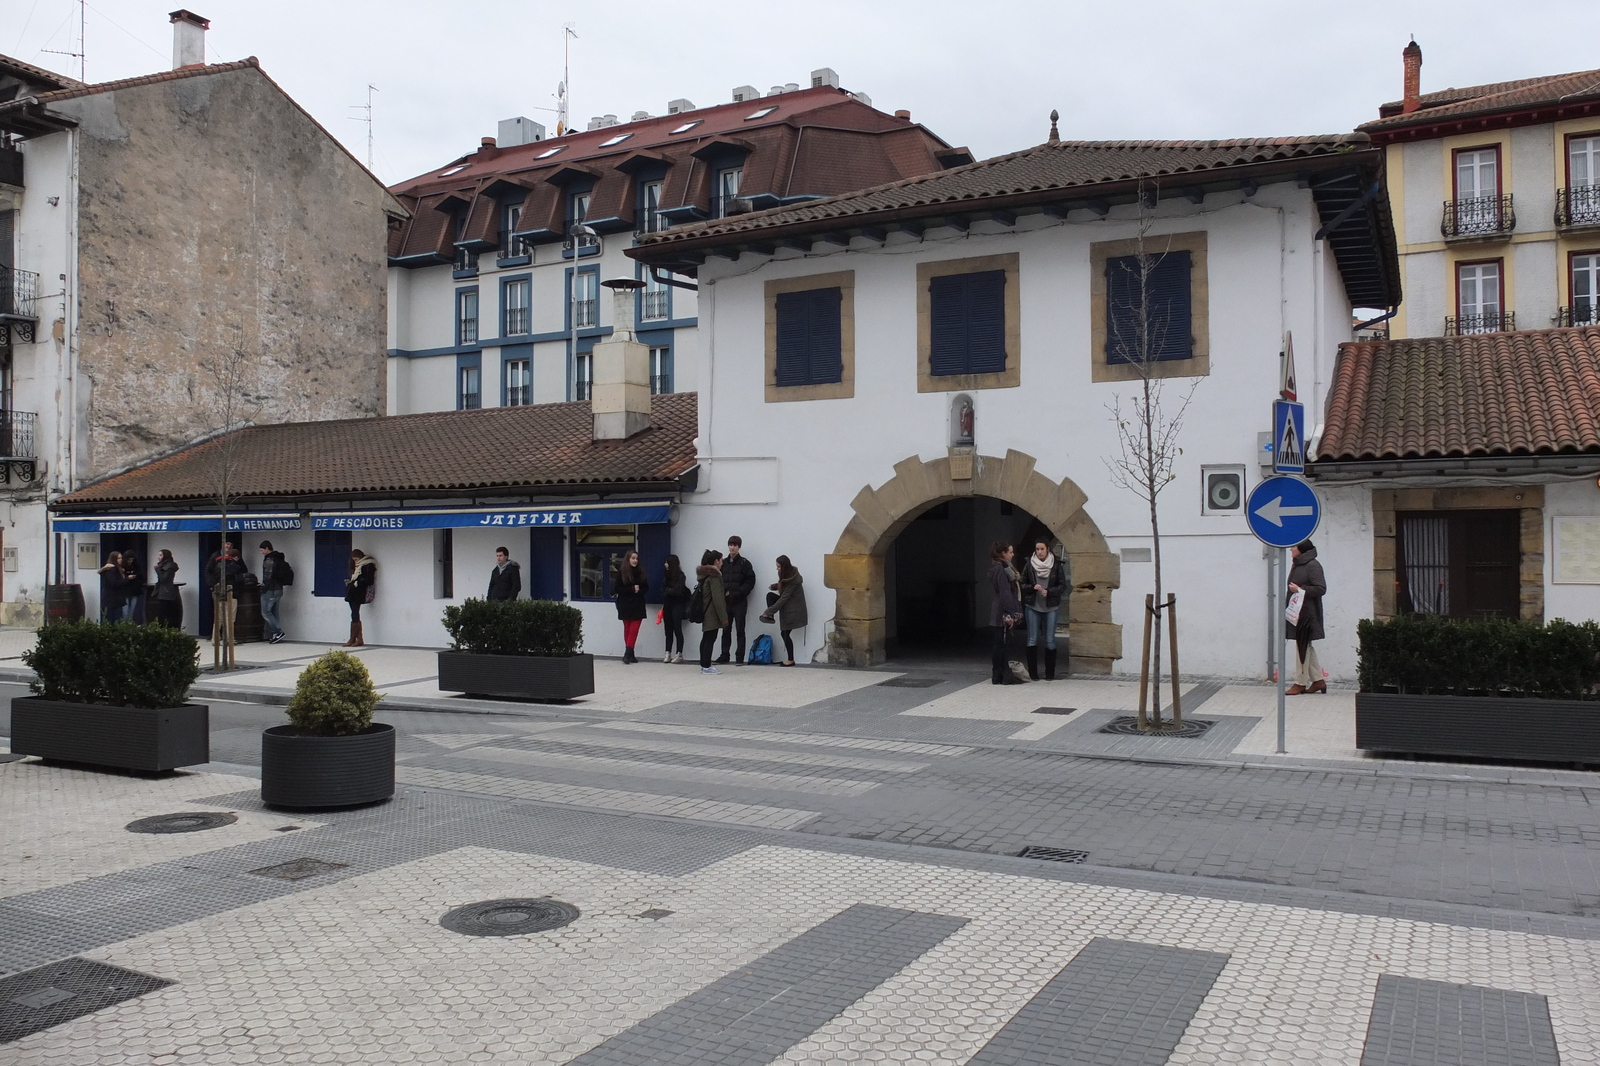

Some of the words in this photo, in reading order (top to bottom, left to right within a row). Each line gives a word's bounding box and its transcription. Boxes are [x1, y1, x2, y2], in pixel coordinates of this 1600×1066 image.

[315, 518, 328, 528] DE
[333, 517, 404, 528] PESCADORES
[480, 512, 582, 525] JATETXEA
[99, 521, 169, 531] RESTAURANTE
[228, 520, 239, 530] LA
[244, 519, 301, 530] HERMANDAD
